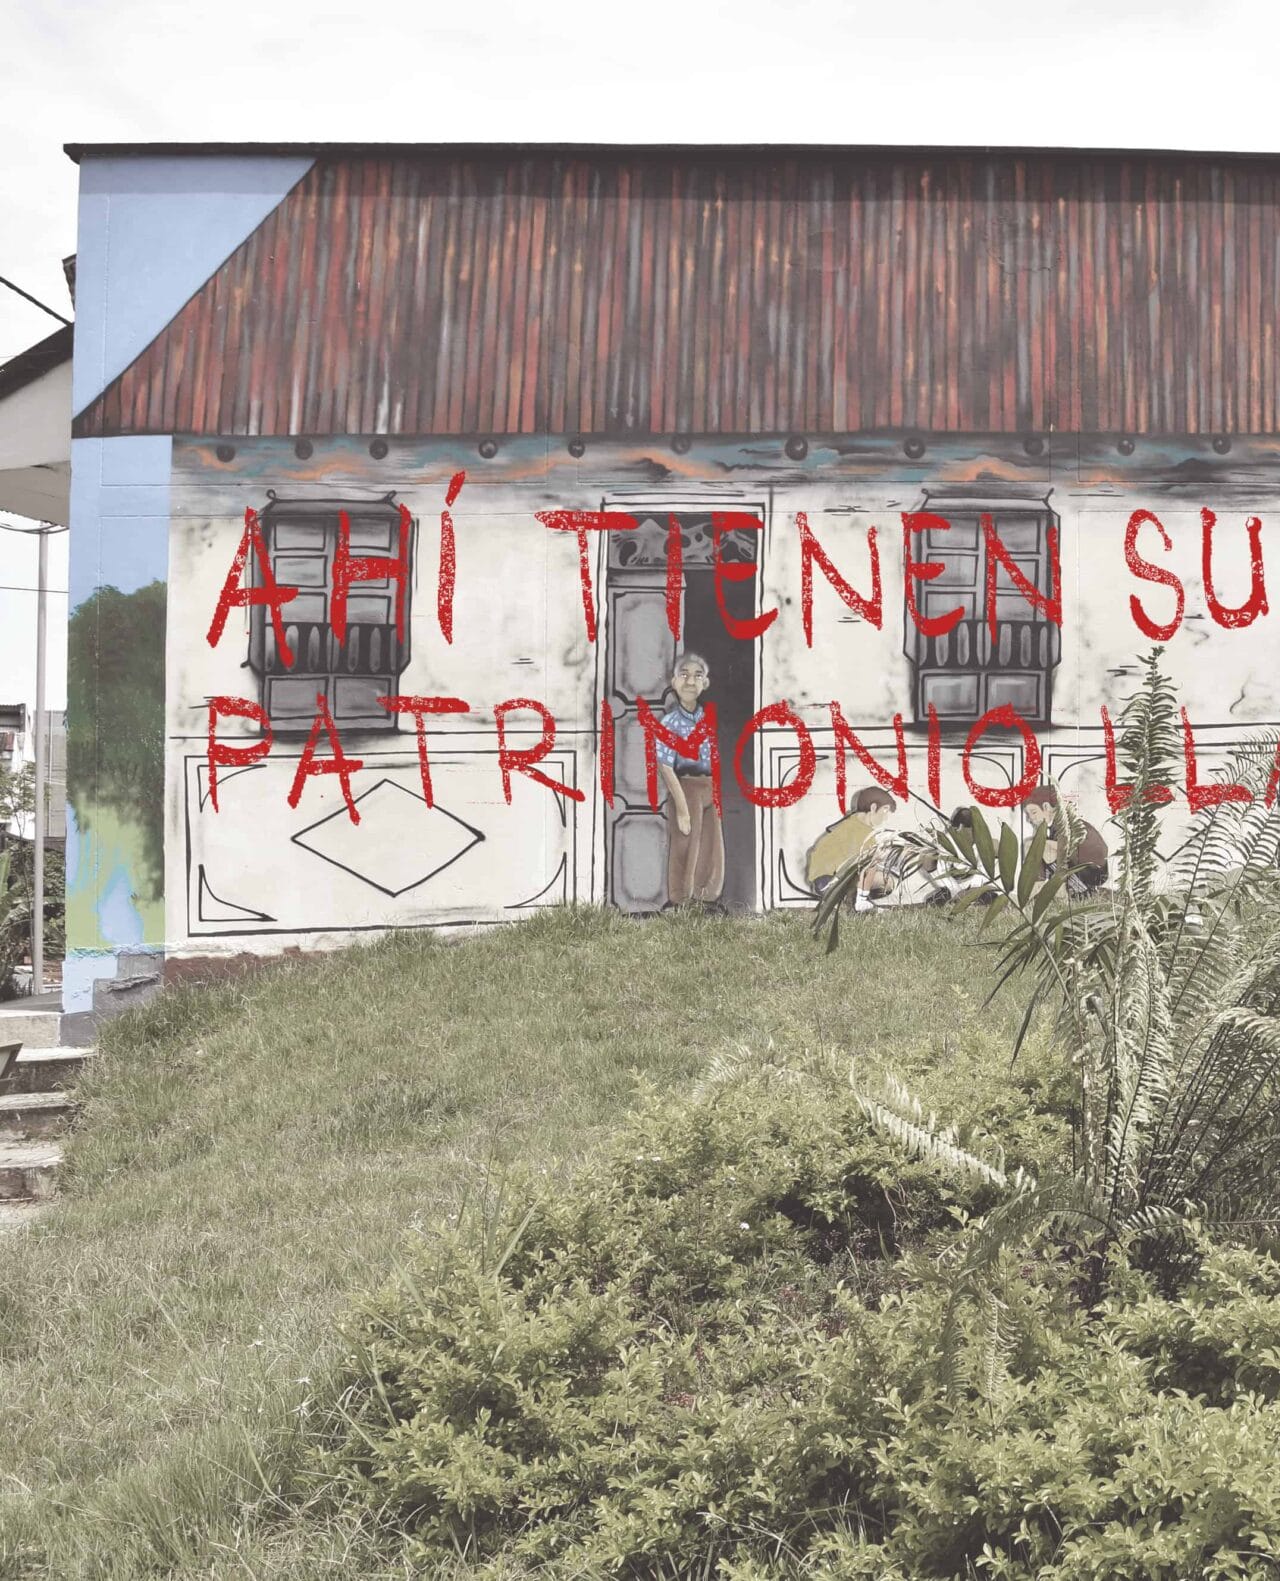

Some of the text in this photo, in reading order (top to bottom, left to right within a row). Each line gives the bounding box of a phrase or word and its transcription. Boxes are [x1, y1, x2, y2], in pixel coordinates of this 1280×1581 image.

[207, 471, 467, 668] AHÍ
[534, 511, 1064, 649] TIENEN
[1124, 508, 1269, 642] SU
[206, 693, 1042, 825] PATRIMONIO
